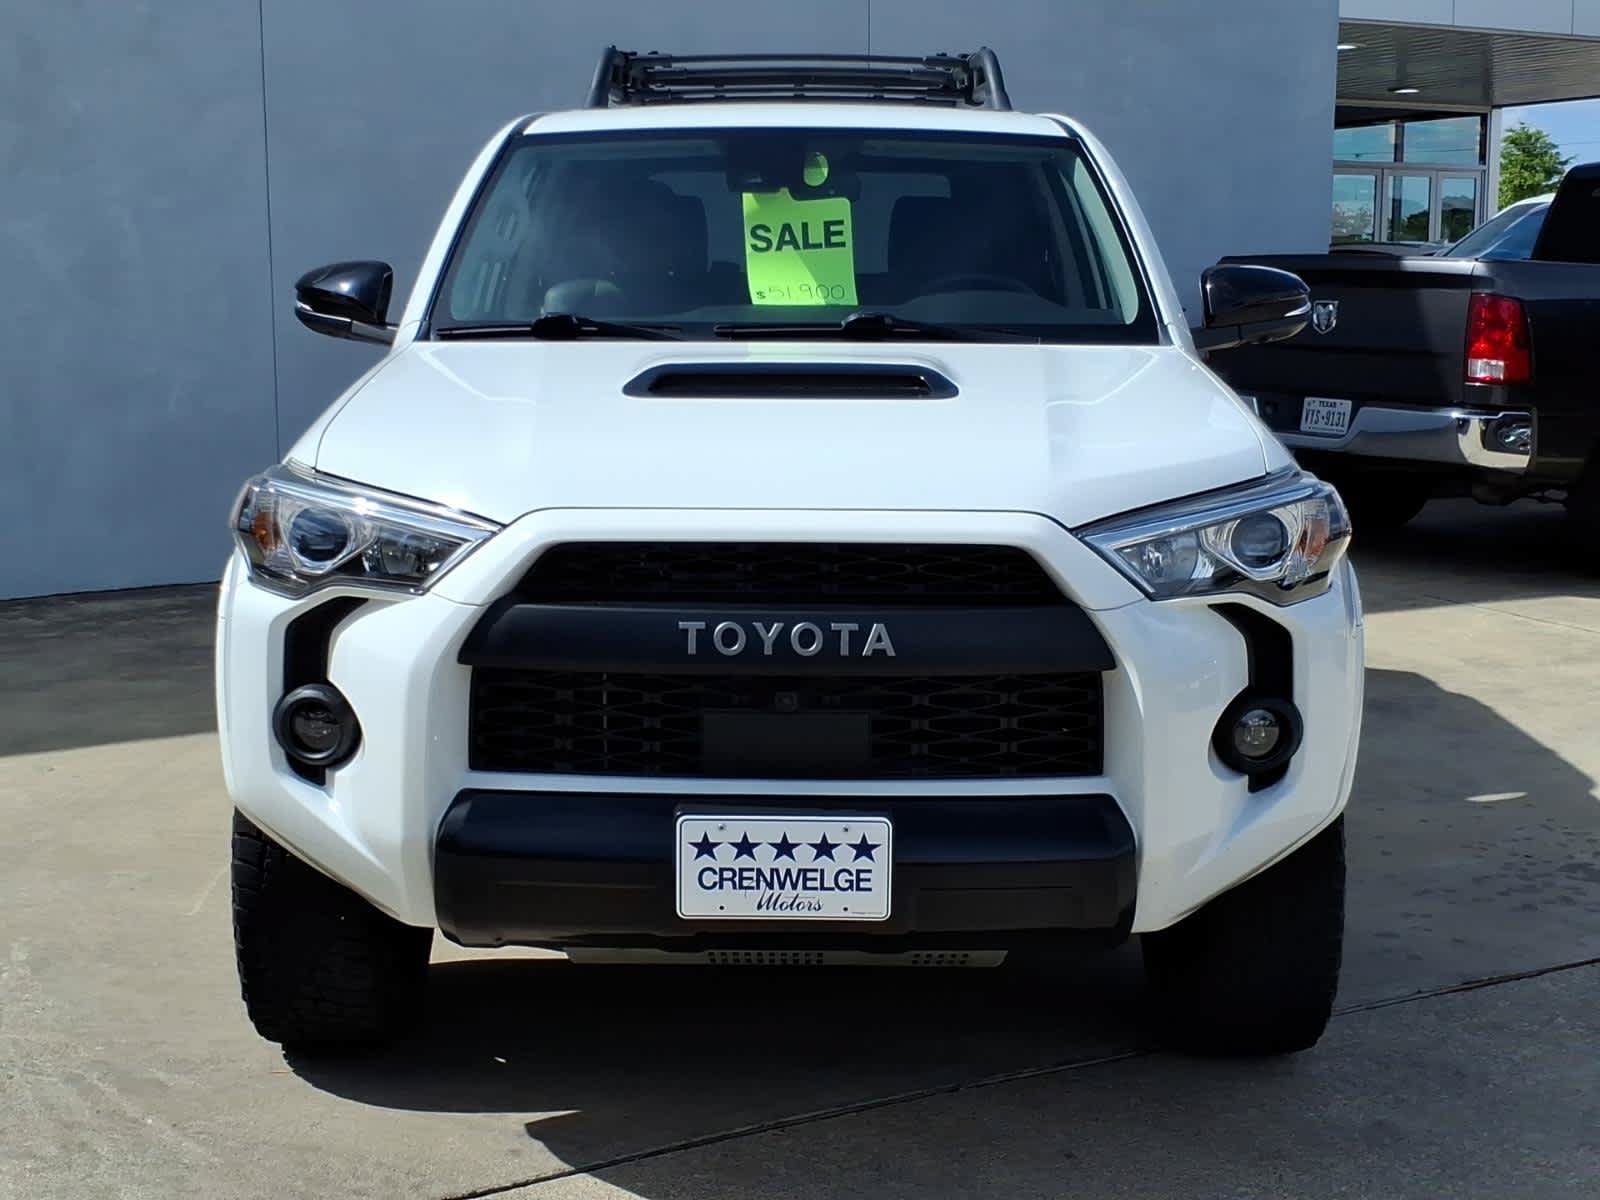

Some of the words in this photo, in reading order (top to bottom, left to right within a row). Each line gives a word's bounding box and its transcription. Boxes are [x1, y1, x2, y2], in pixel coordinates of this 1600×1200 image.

[750, 220, 846, 253] SALE
[1319, 400, 1337, 408] TEXAS
[678, 621, 896, 656] TOYOTA
[697, 866, 873, 892] CRENWELGE
[756, 889, 823, 912] Motors
